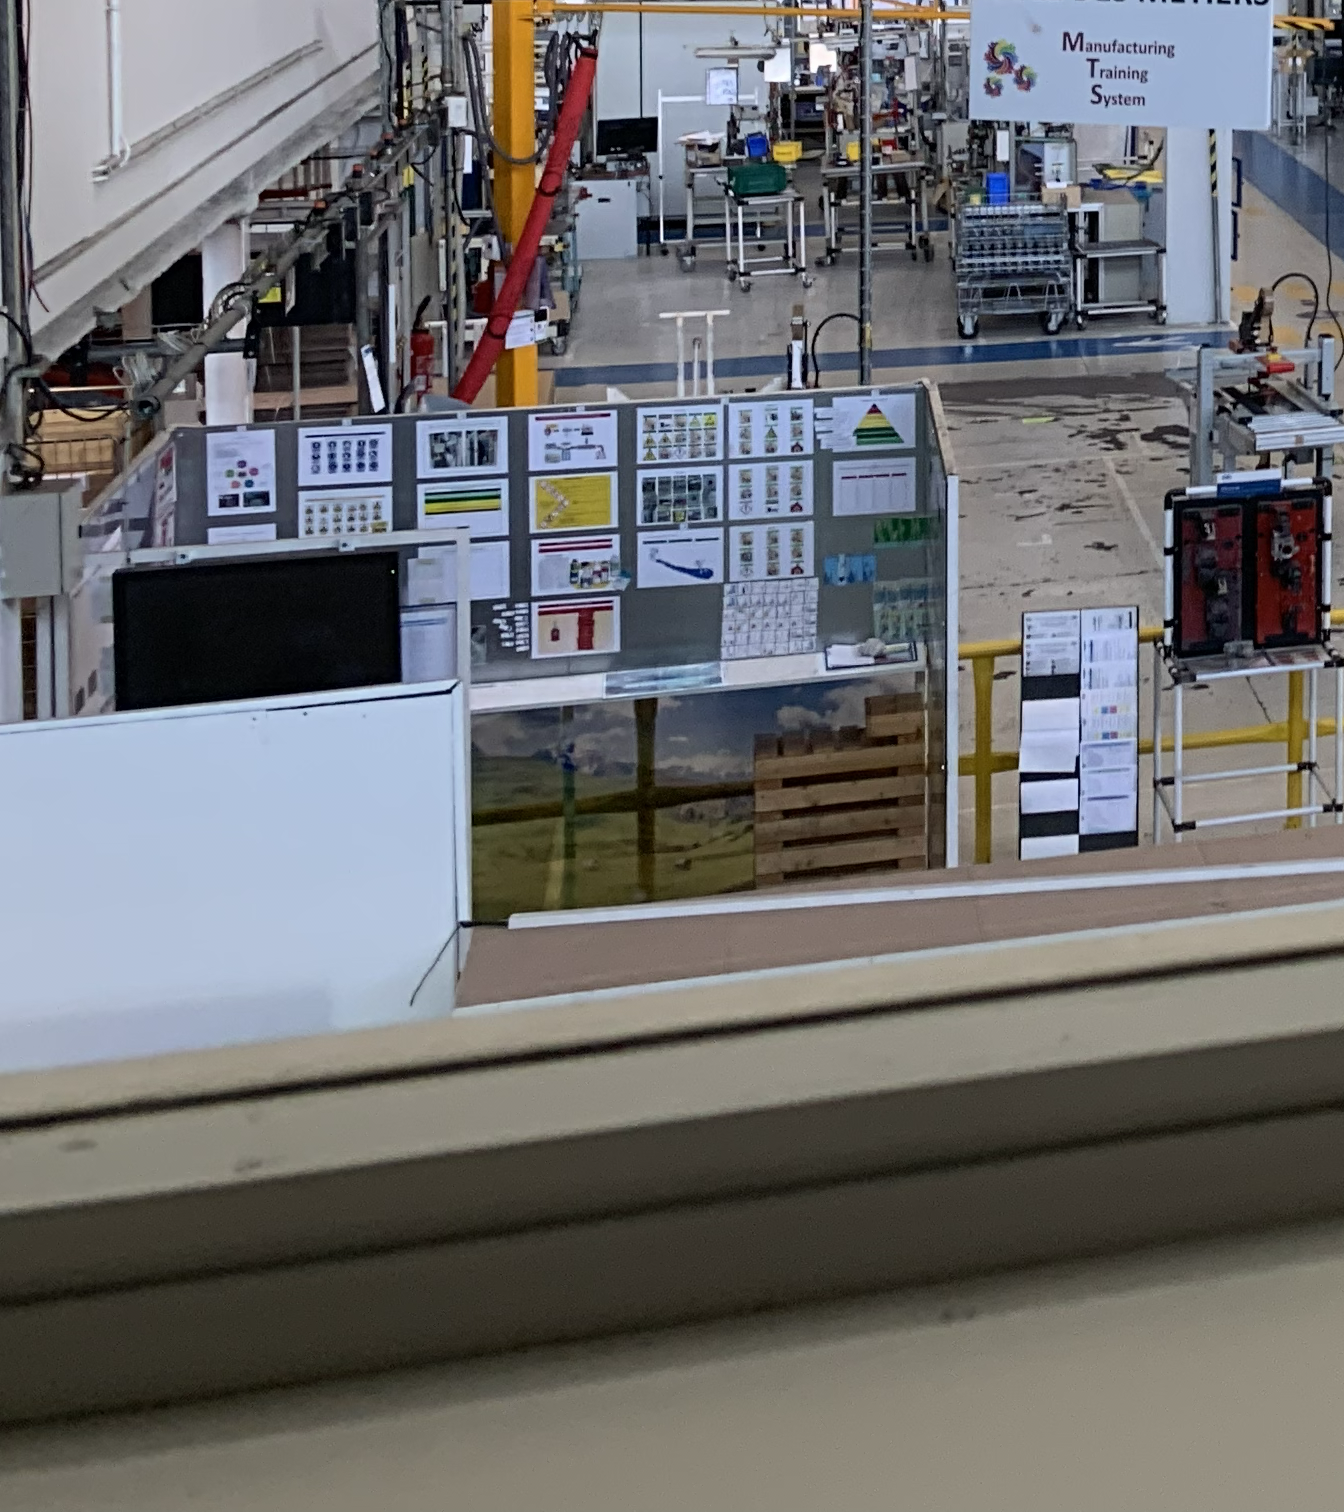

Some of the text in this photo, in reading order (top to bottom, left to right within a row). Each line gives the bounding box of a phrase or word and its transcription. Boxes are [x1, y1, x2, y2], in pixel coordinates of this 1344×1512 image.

[1062, 31, 1175, 58] Manufacturing
[1086, 58, 1149, 83] Training
[1090, 84, 1146, 108] System
